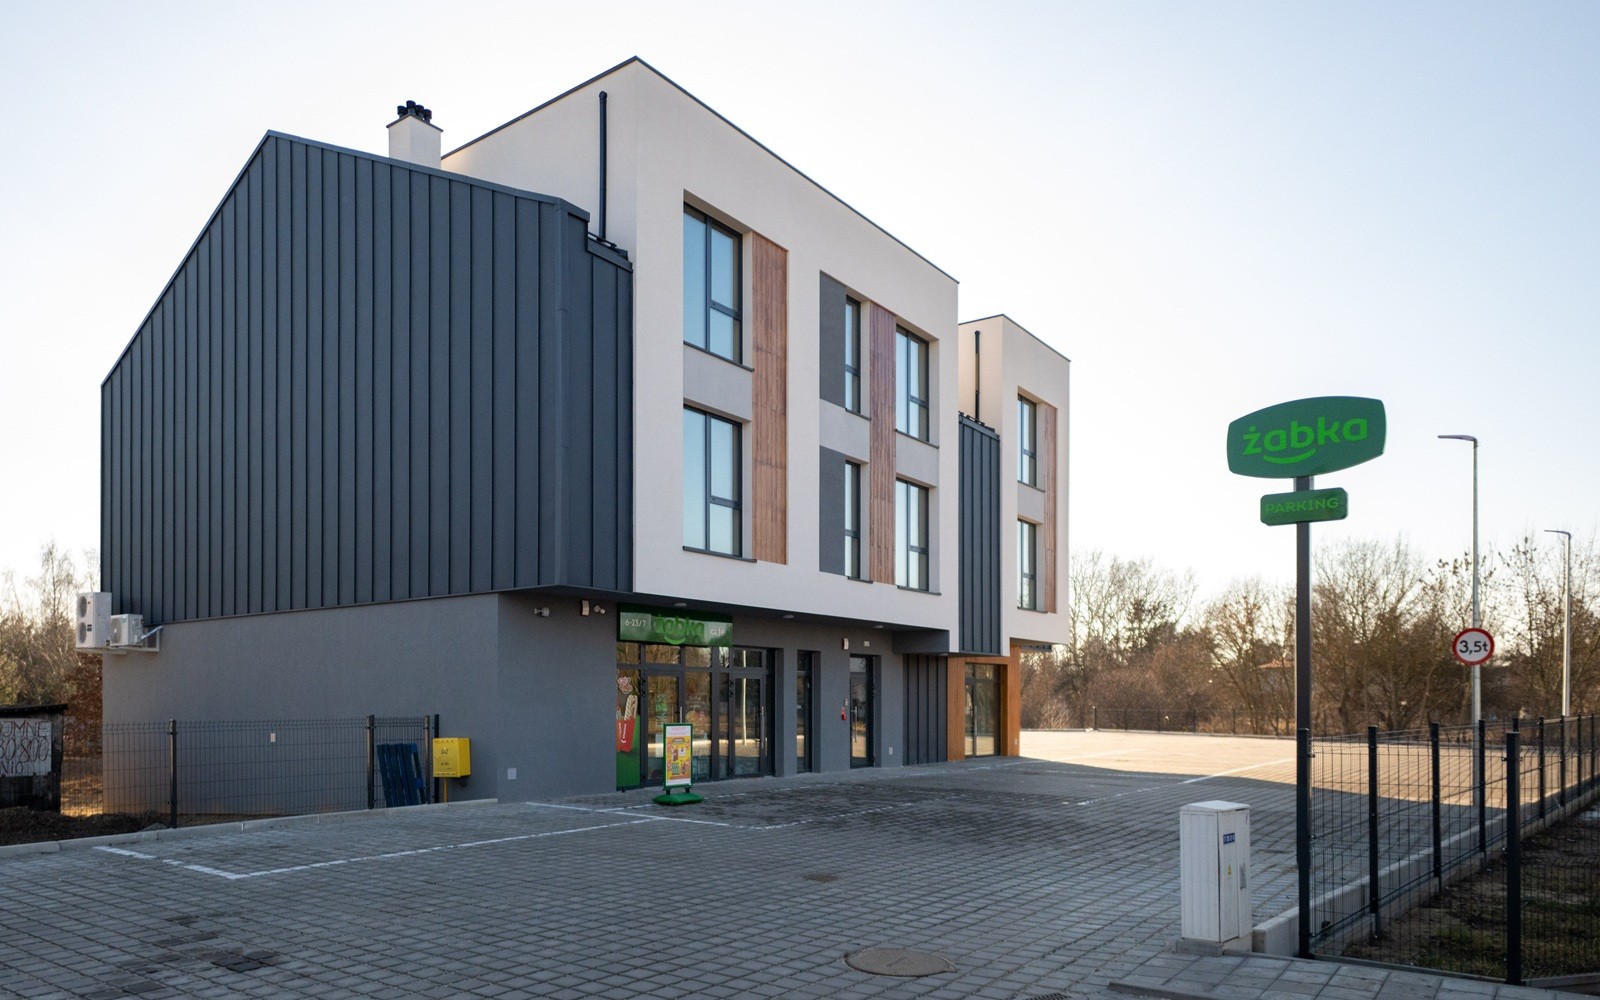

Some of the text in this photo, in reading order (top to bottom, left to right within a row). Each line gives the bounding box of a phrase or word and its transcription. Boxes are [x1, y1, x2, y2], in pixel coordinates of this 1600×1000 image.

[1242, 416, 1368, 458] żabka
[1265, 497, 1340, 515] PARKING
[624, 619, 647, 628] 6-23/7
[1459, 639, 1489, 655] 3,5t
